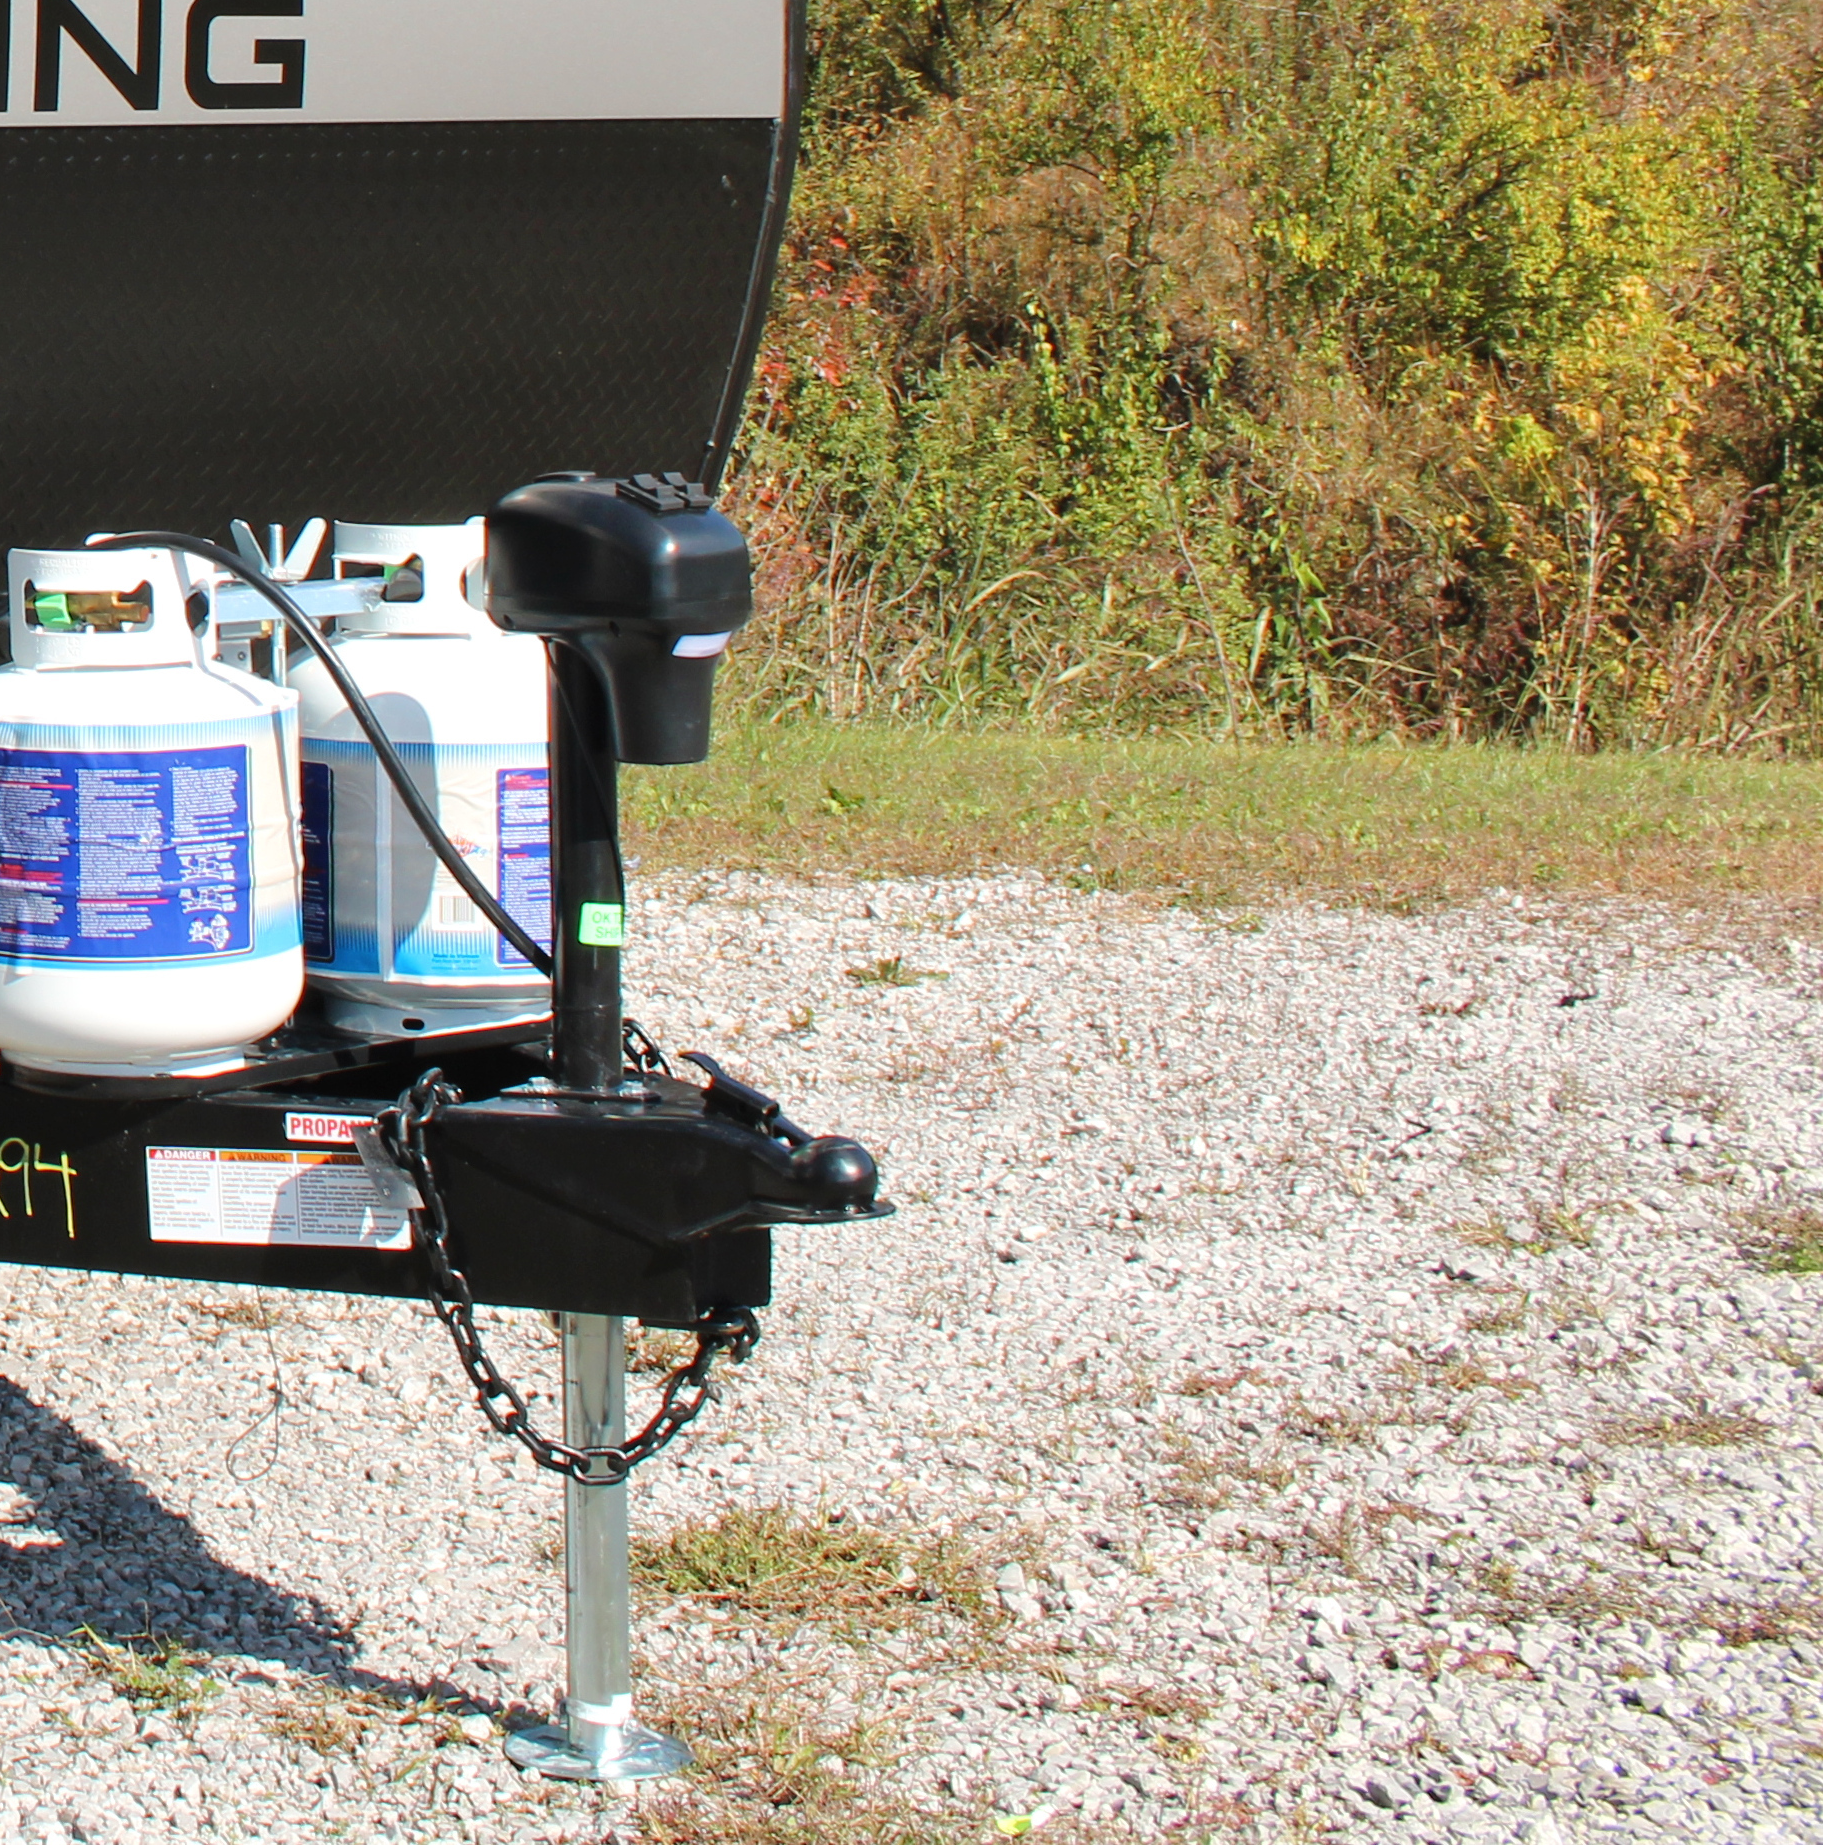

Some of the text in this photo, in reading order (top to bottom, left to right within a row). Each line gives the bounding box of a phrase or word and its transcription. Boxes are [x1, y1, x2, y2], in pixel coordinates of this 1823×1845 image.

[289, 1116, 373, 1139] PROPA
[164, 1150, 211, 1160] DANGER
[238, 1153, 287, 1163] WARNING
